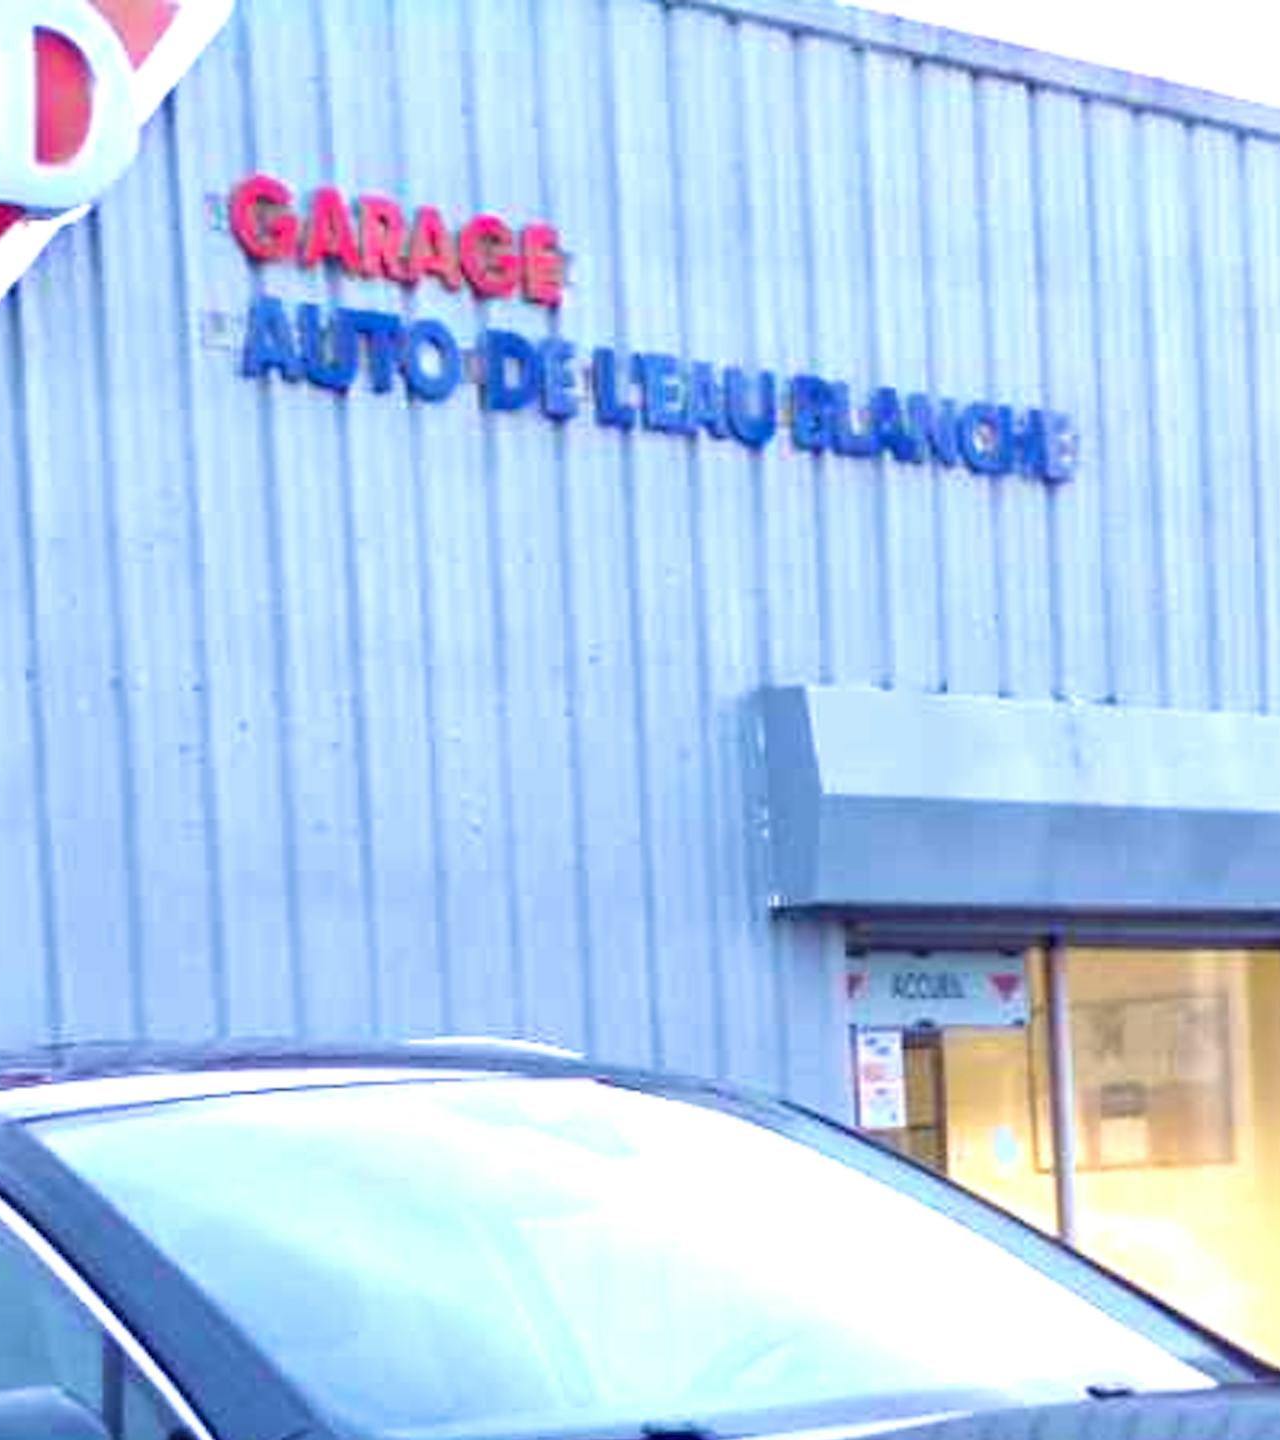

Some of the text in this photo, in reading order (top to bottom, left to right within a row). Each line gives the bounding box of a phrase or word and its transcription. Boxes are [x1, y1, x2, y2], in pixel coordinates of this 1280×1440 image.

[227, 174, 563, 306] GARAGE
[242, 296, 1080, 486] AUTO DE L'EAU BLANCHE
